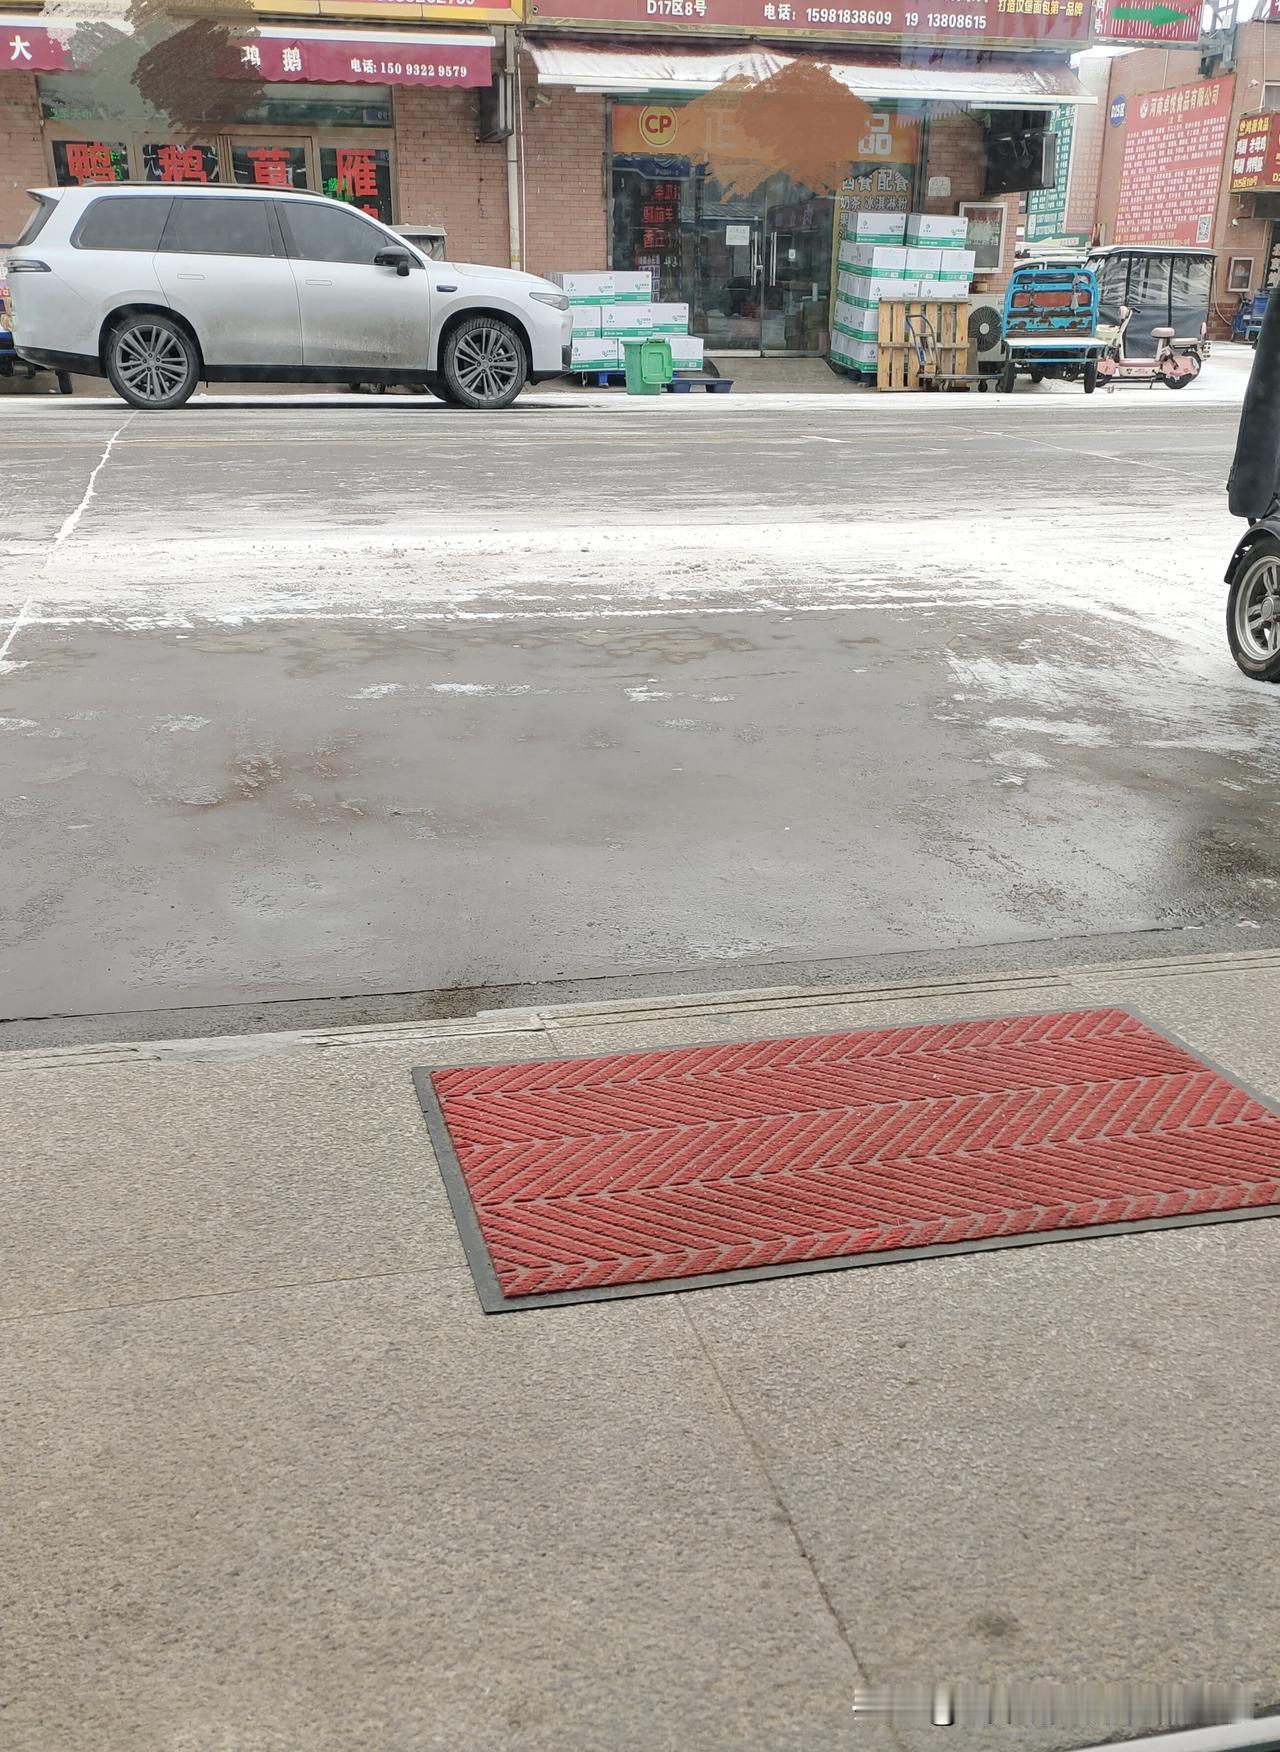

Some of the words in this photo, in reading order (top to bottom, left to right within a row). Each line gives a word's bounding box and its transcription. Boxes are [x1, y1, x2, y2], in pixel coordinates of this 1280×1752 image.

[646, 0, 708, 16] D17区8号
[806, 8, 891, 25] 15981838609
[9, 35, 33, 61] 大
[380, 62, 402, 74] 150
[406, 64, 435, 76] 9322
[438, 65, 467, 78] 9579
[645, 115, 672, 133] CP
[336, 148, 379, 197] 雁
